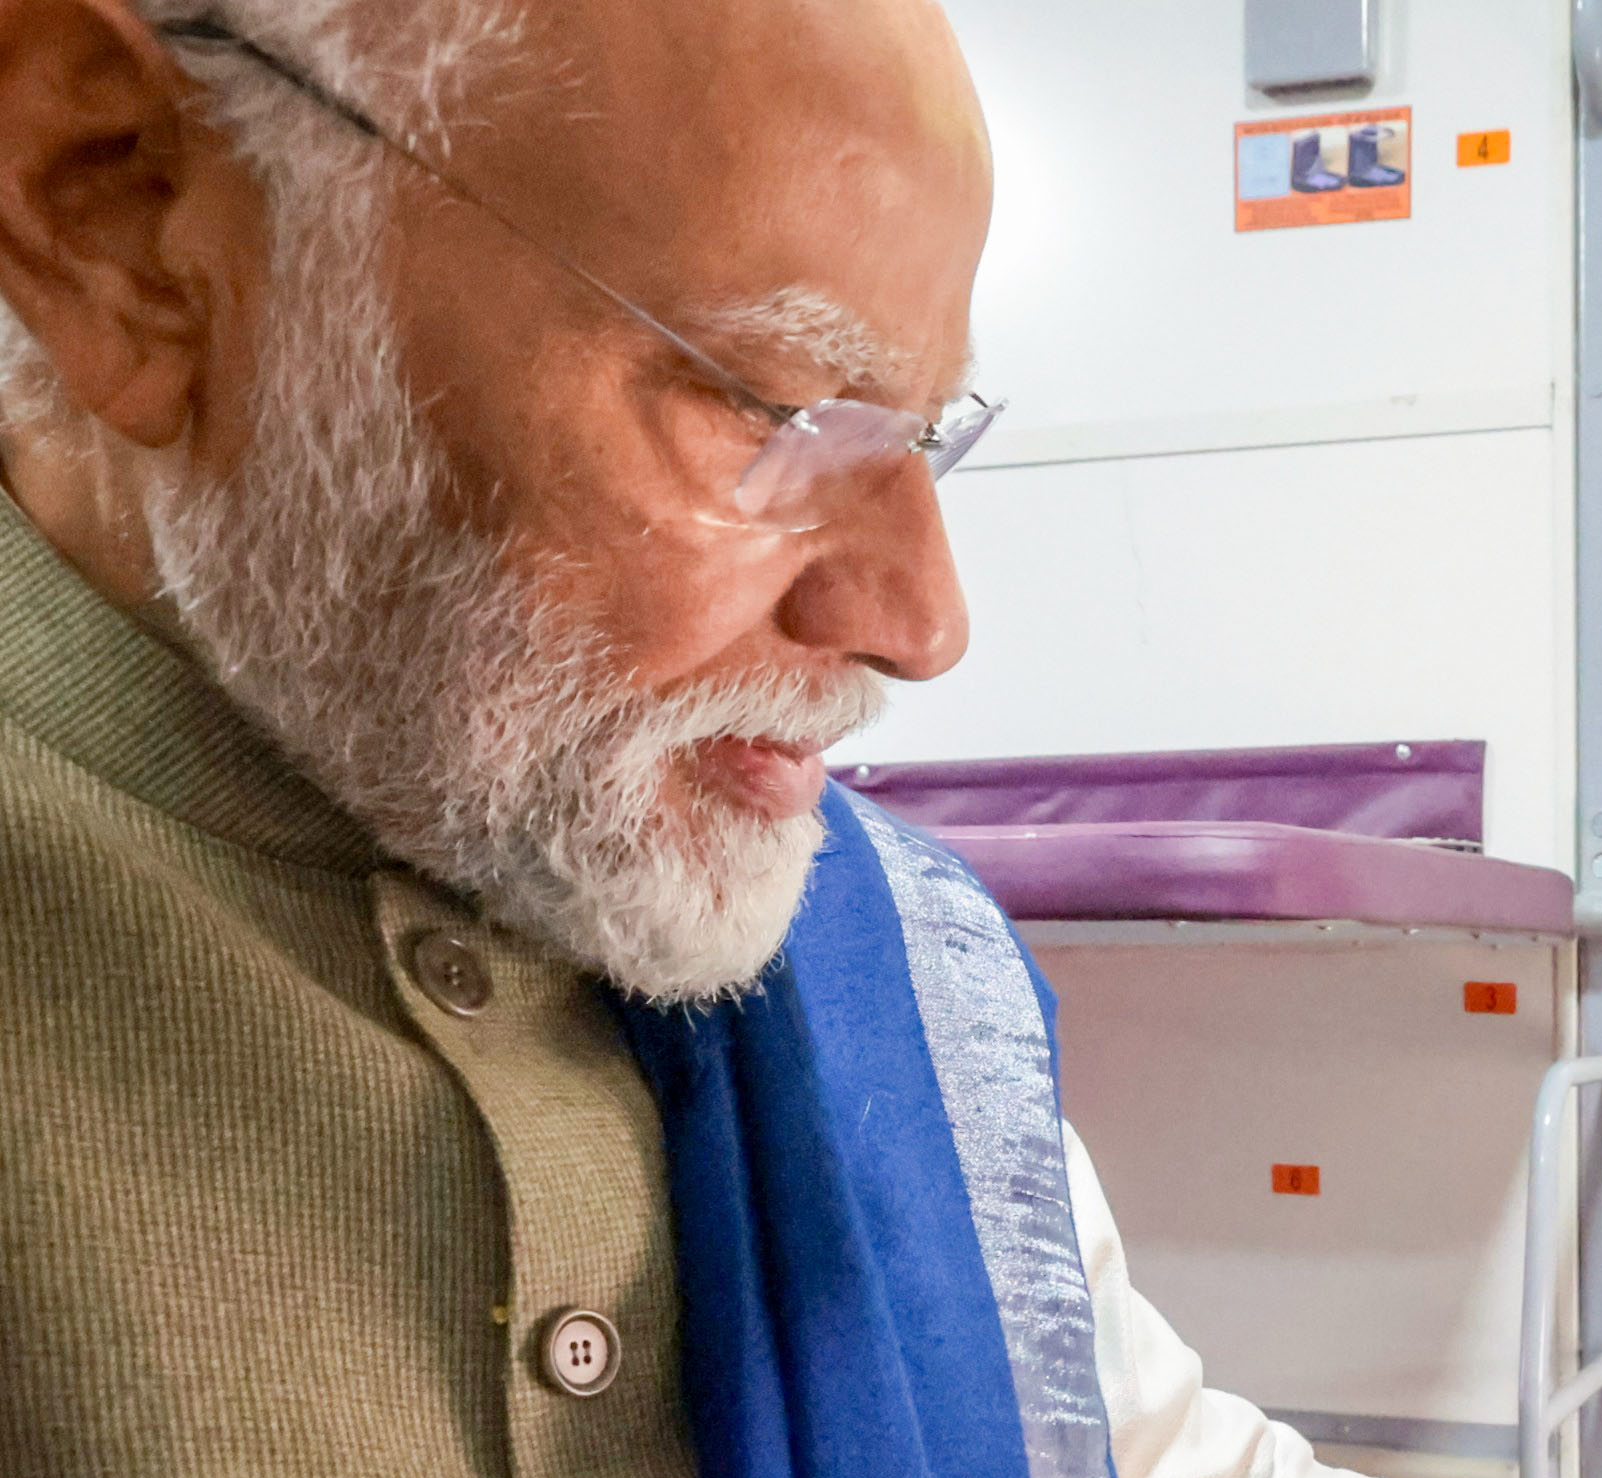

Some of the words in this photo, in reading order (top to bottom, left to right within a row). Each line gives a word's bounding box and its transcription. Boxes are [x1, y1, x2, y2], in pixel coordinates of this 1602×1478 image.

[1477, 135, 1489, 160] 4
[1485, 985, 1497, 1011] 3
[1290, 1167, 1302, 1192] 6
